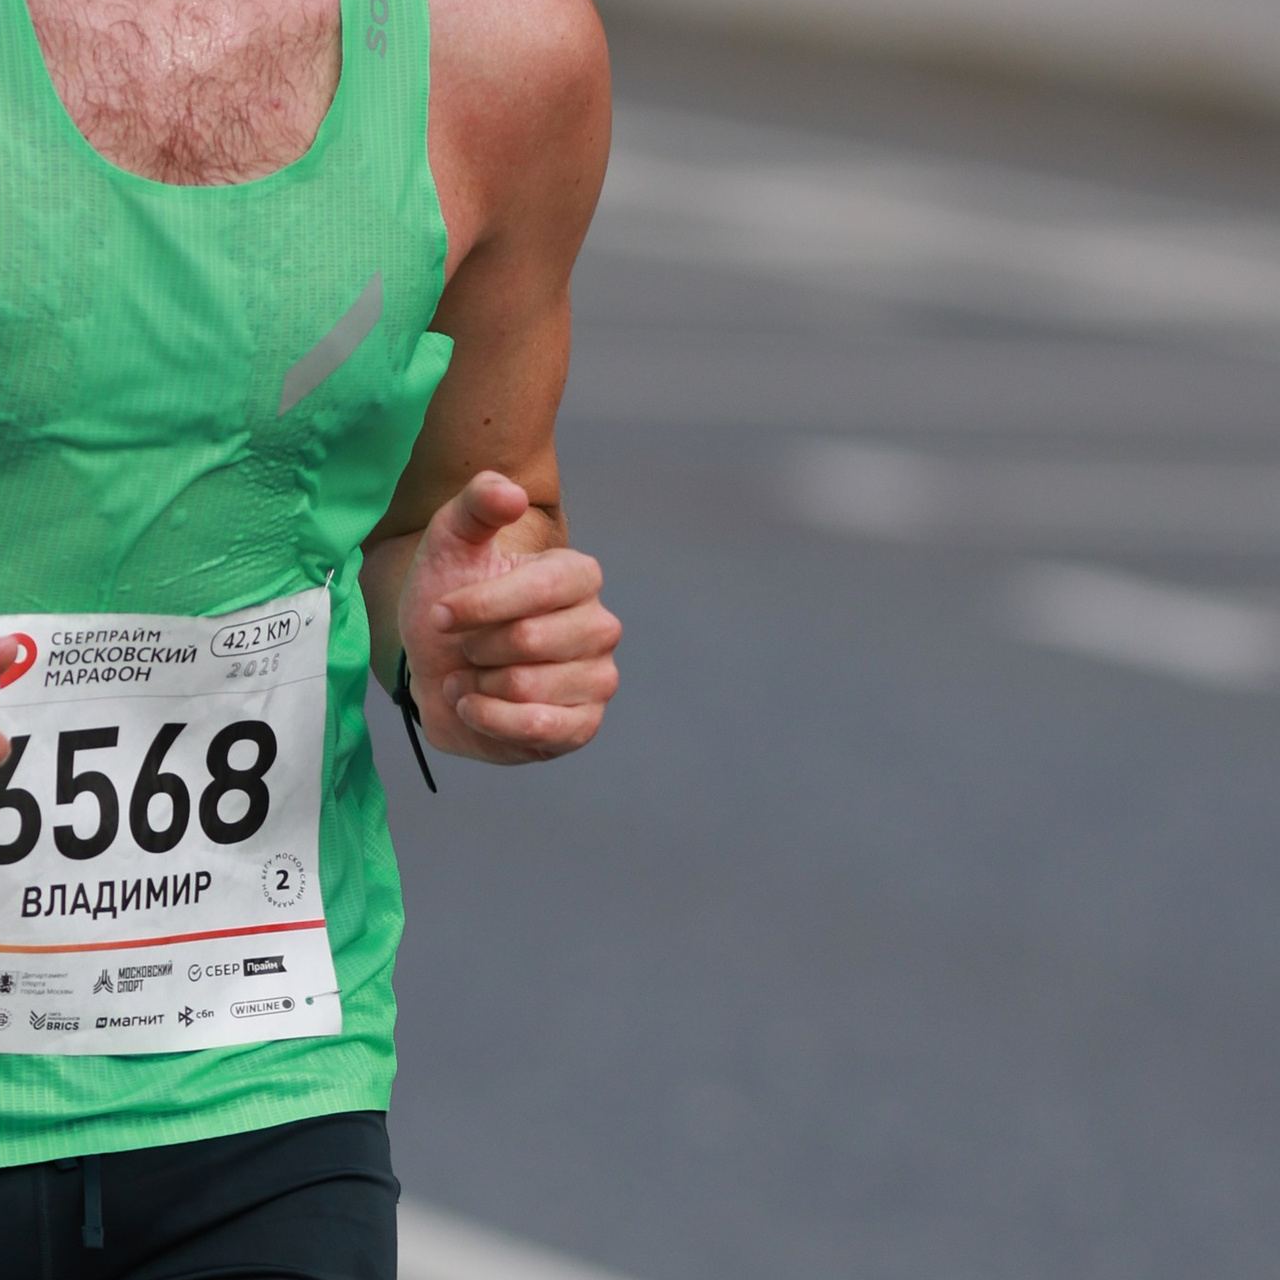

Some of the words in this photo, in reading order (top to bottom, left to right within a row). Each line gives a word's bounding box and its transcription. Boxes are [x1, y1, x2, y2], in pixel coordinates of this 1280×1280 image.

[51, 628, 162, 645] СБЕРПРАЙМ
[222, 625, 262, 651] 42,2
[48, 645, 197, 666] МОСКОВСКИЙ
[44, 666, 152, 687] МАРАФОН
[275, 869, 291, 891] 2
[21, 871, 212, 920] ВЛАДИМИР
[117, 960, 173, 980] МОСКОВСКИЙ
[205, 963, 241, 978] СБЕР
[246, 959, 279, 974] Прайм
[116, 979, 144, 993] СПОРТ
[235, 1001, 280, 1014] WINLINE
[46, 1021, 80, 1031] BRICS
